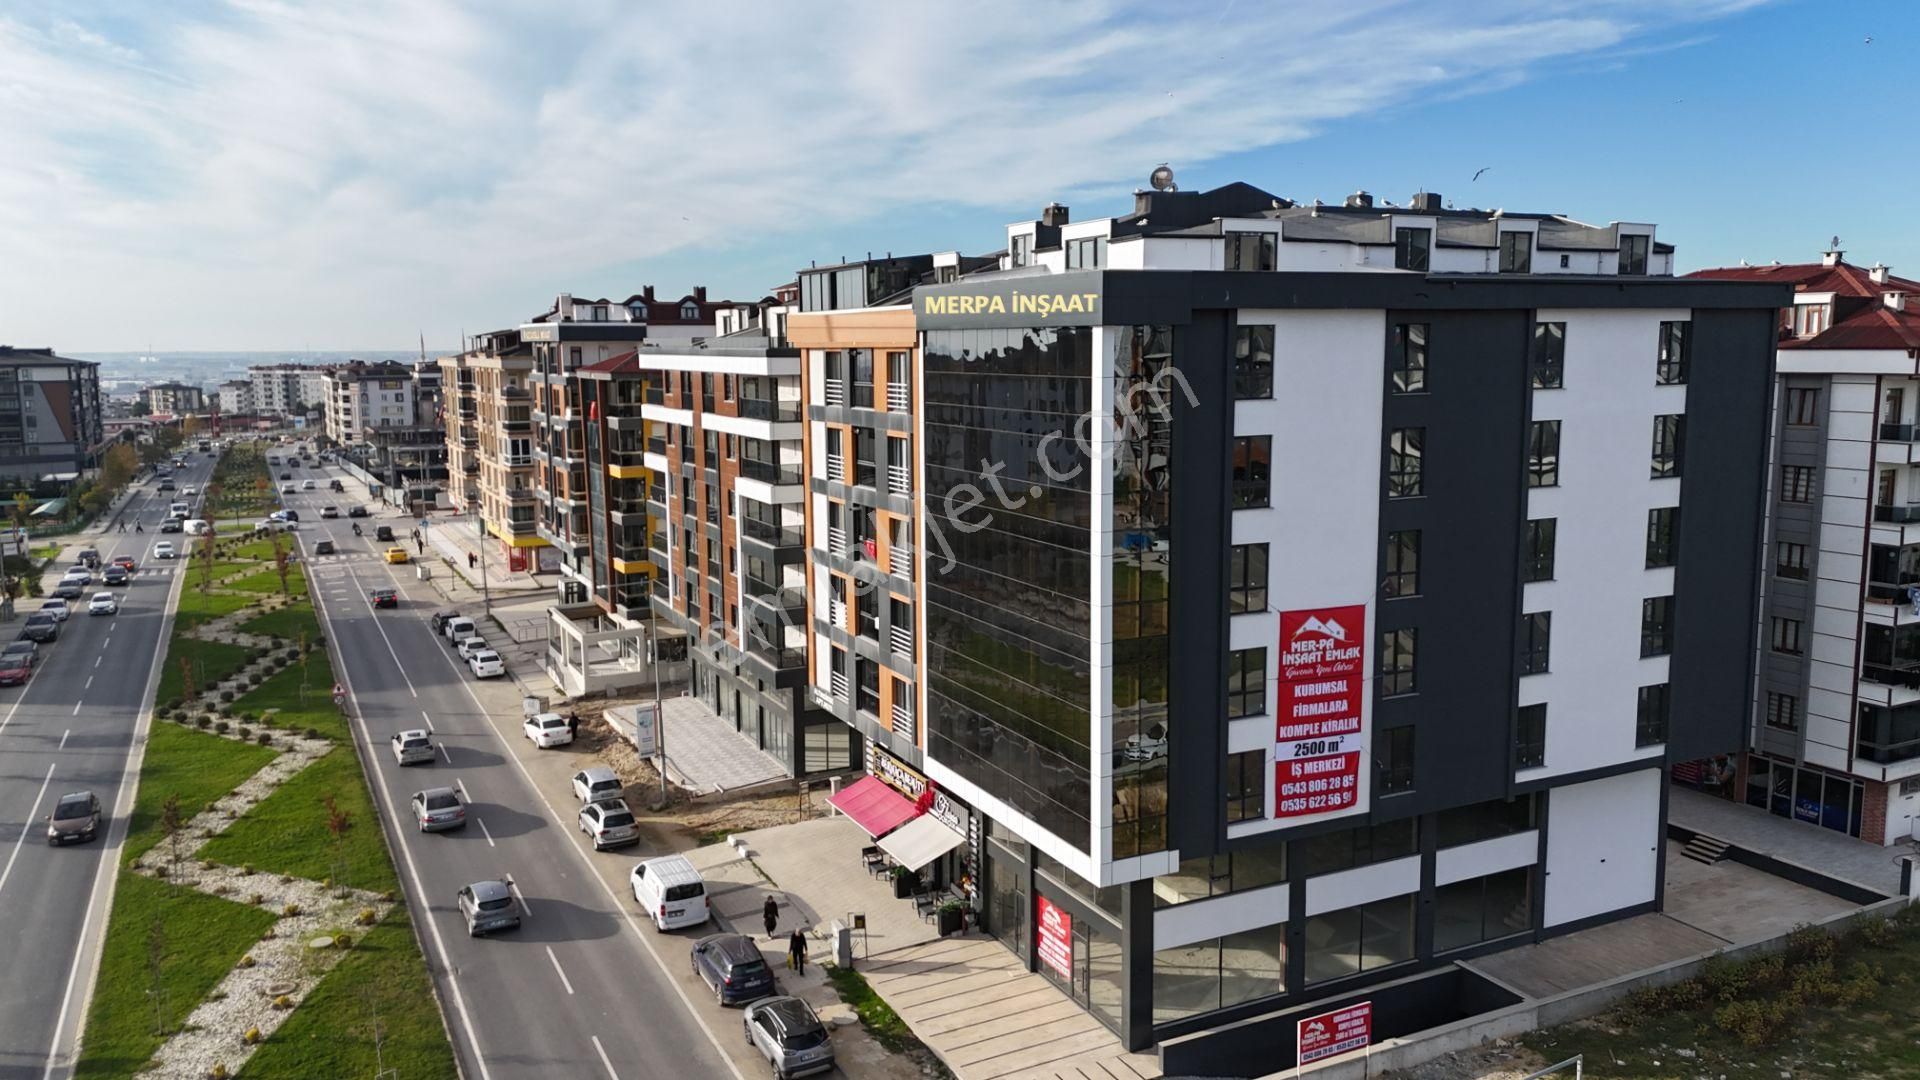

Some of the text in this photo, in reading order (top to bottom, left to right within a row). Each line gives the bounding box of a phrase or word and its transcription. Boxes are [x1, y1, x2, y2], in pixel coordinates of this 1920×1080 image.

[925, 290, 1098, 318] MERPA İNŞAAT
[1291, 638, 1335, 653] MER-PA
[1283, 646, 1361, 666] İNŞAAT EMLAK
[1294, 680, 1348, 697] KURUMSAL
[1293, 699, 1348, 717] FİRMALARA
[1280, 717, 1359, 738] KOMPLE KİRALIK
[1294, 740, 1326, 757] 2500
[1291, 755, 1346, 778] İŞ MERKEZİ
[1281, 781, 1307, 796] 0543
[1308, 778, 1328, 793] 806
[1329, 776, 1341, 790] 28
[1281, 797, 1306, 812] 0535
[1308, 794, 1327, 809] 622
[1328, 792, 1341, 806] 56
